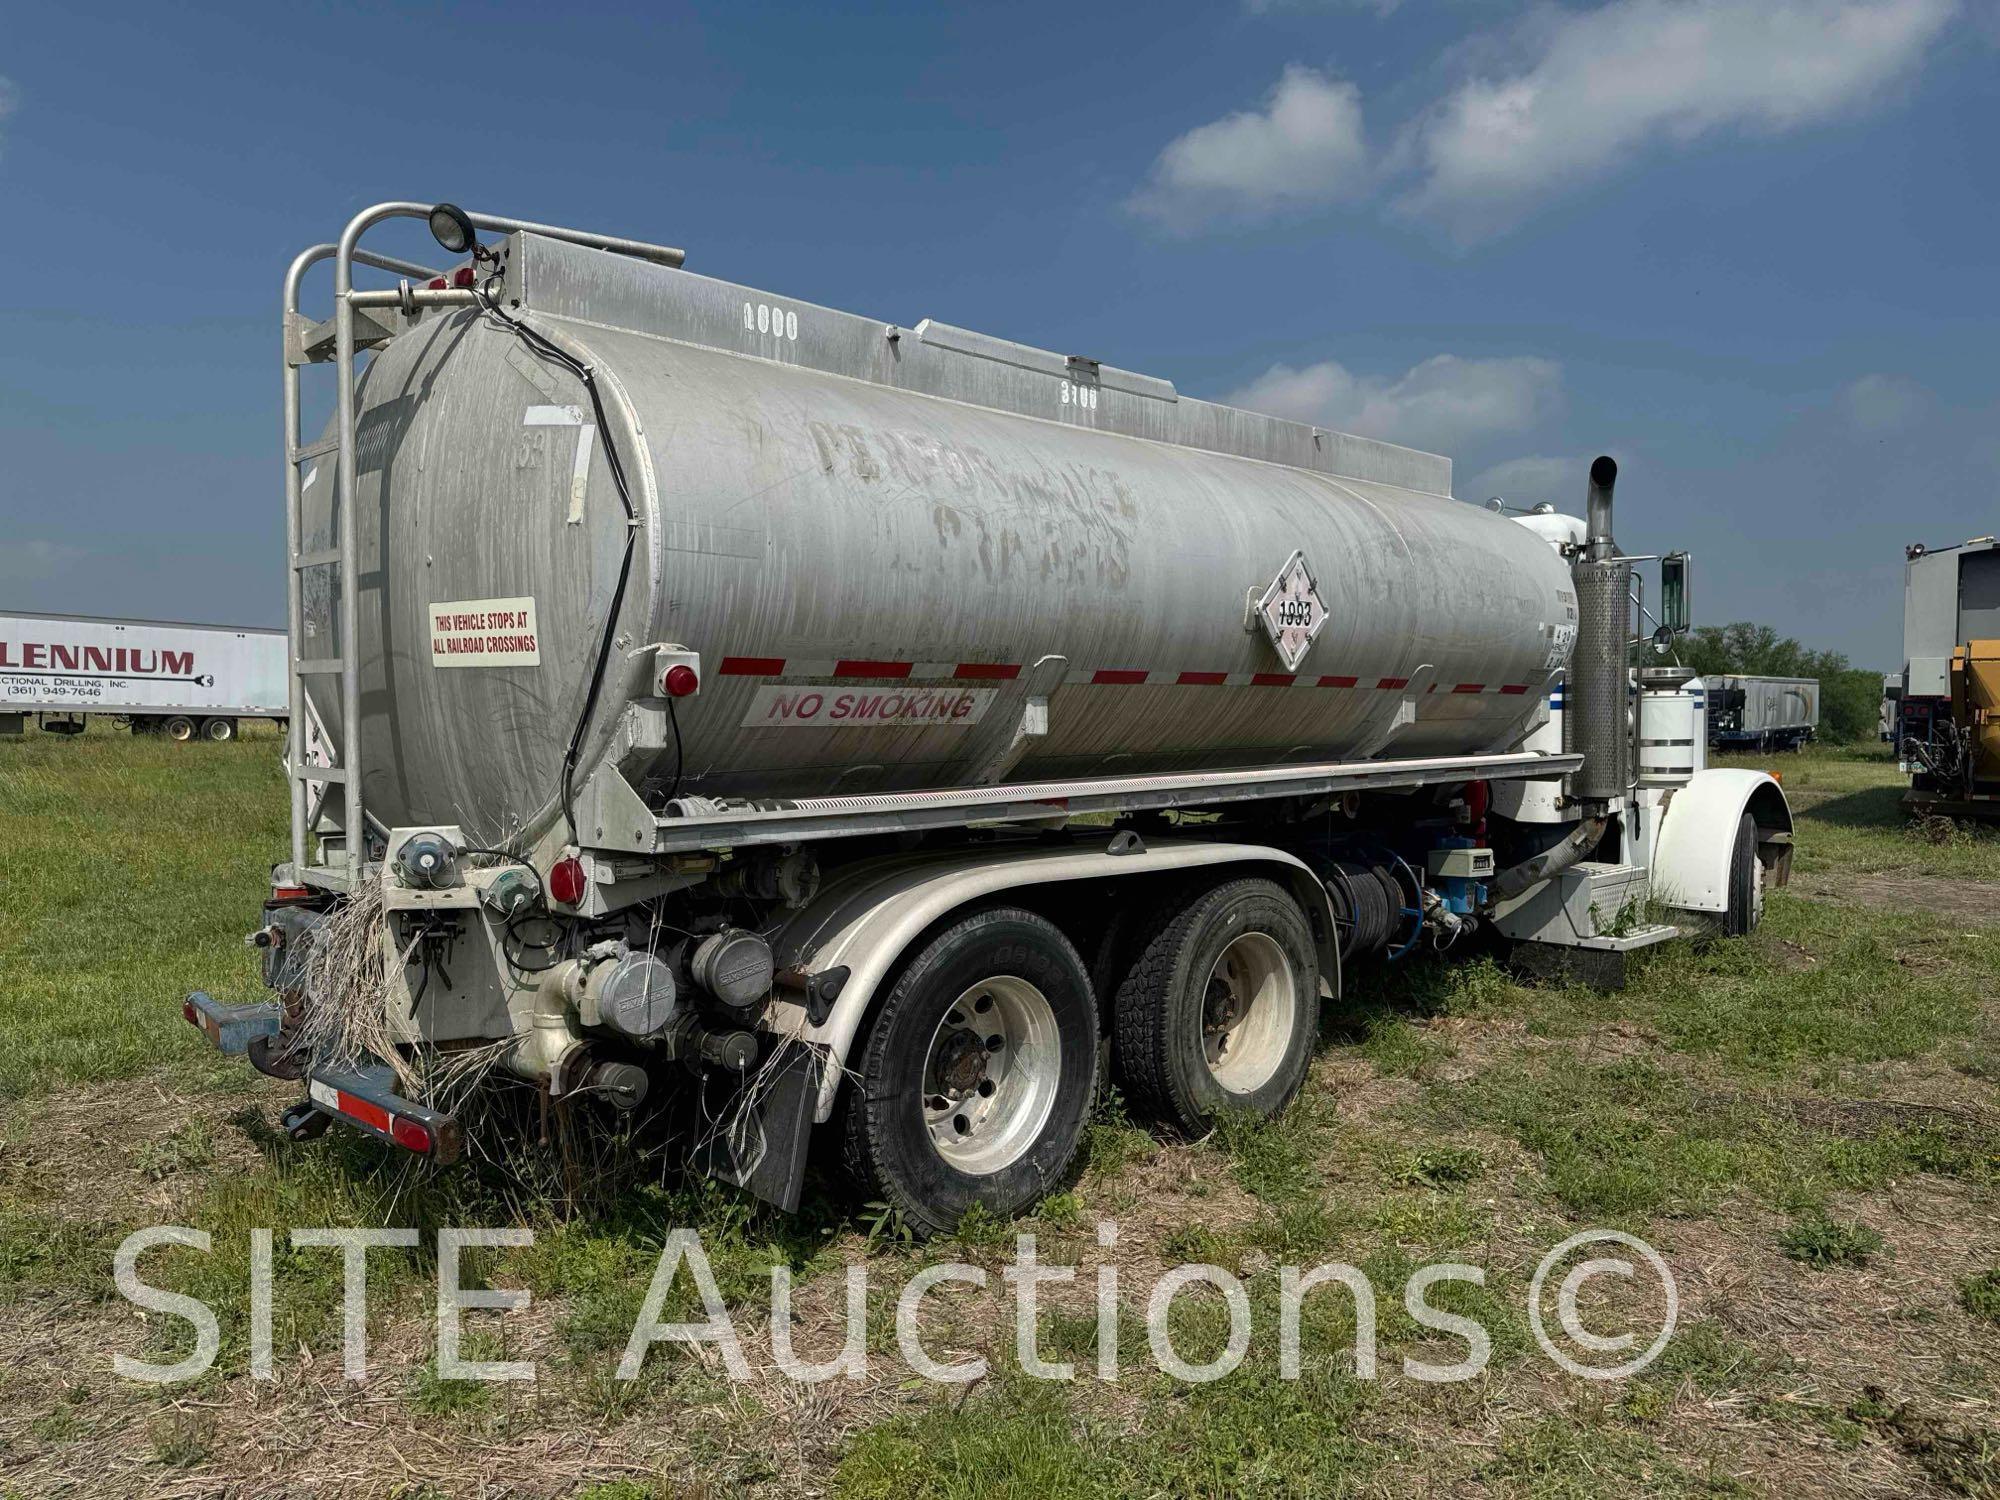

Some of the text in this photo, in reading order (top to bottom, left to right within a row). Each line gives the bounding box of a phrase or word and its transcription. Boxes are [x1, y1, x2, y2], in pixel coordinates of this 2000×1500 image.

[435, 611, 528, 631] THIS VEHICLE STOPS AT
[433, 634, 536, 654] ALL RAILROAD CROSSINGS
[0, 641, 194, 675] LENNIUM
[7, 686, 101, 697] (361) 949-7646
[768, 693, 975, 720] NO SMOKING
